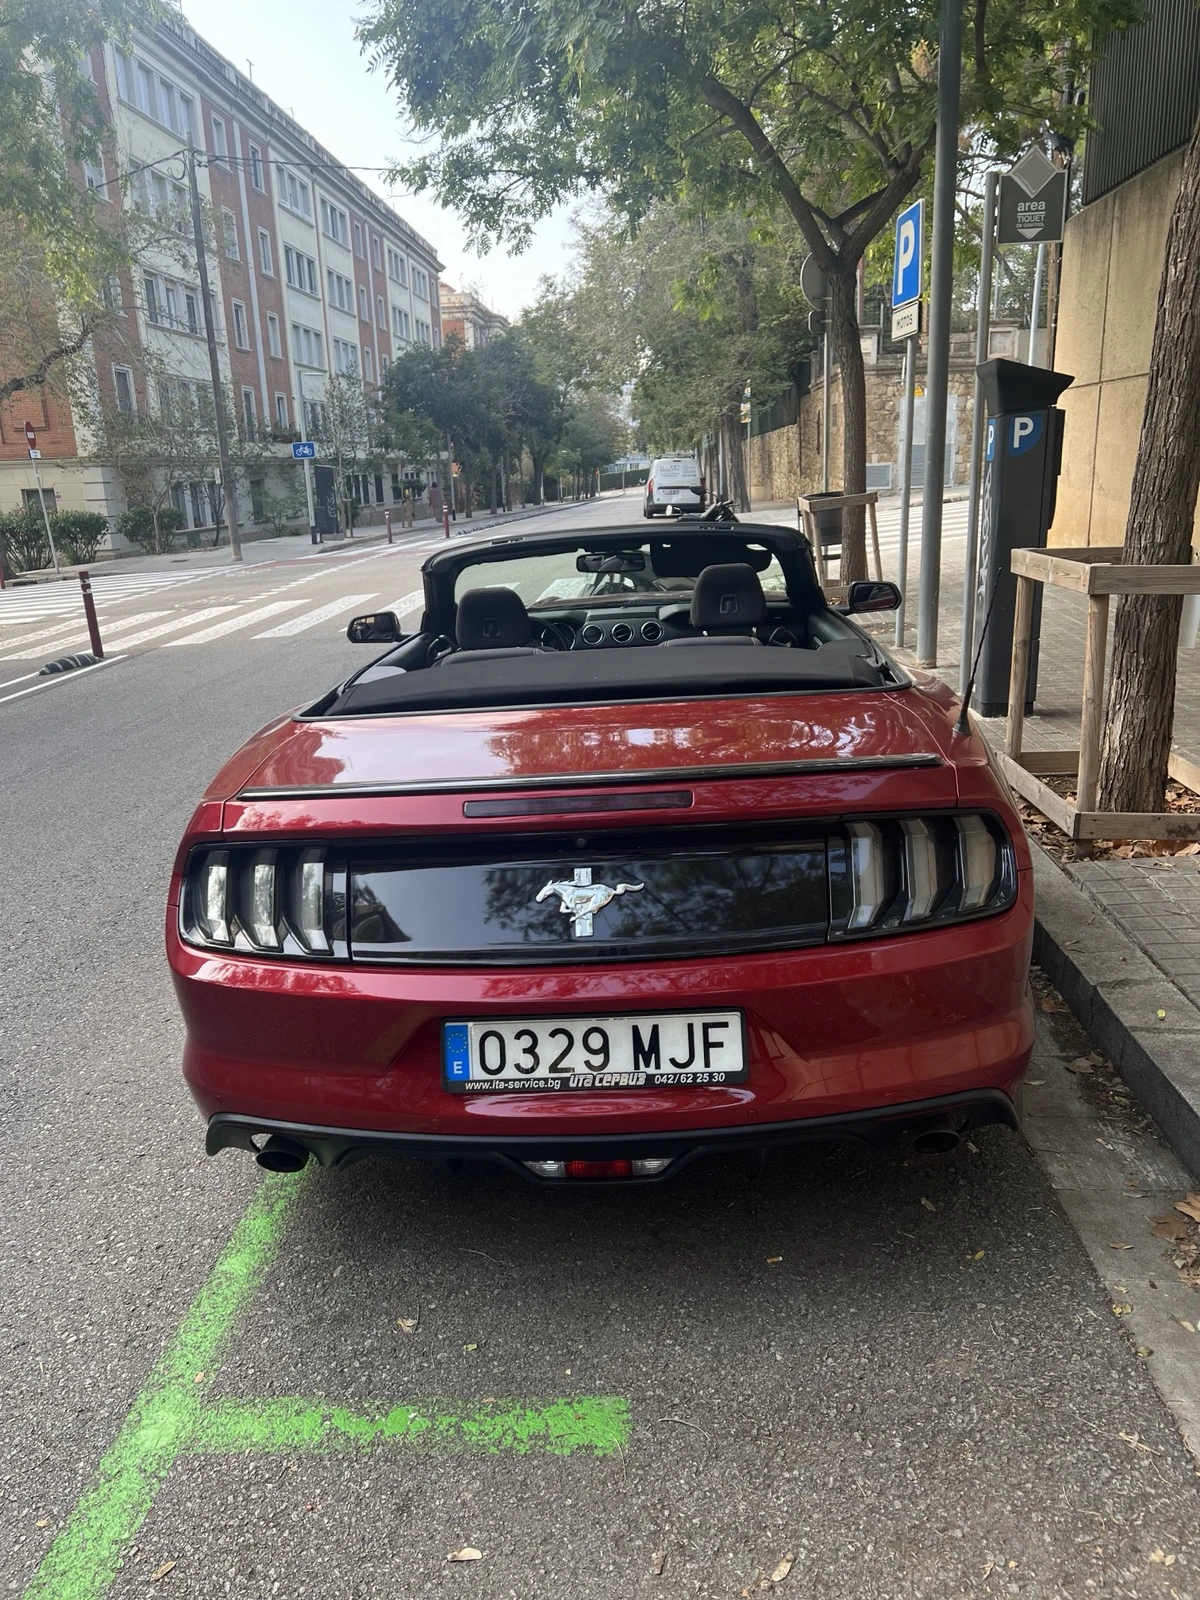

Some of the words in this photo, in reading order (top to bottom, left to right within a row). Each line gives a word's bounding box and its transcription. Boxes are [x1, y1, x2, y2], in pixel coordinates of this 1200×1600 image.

[1017, 201, 1046, 212] area
[1017, 214, 1046, 223] TIQUET
[897, 219, 915, 296] P
[896, 313, 913, 331] MOTOS
[1013, 416, 1034, 448] P
[987, 425, 994, 456] P
[478, 1026, 610, 1076] 0329
[631, 1021, 730, 1071] MJF
[453, 1061, 463, 1074] E
[465, 1078, 562, 1090] www.ita-service.bg
[654, 1073, 693, 1084] 042/62
[696, 1073, 709, 1083] 25
[712, 1072, 726, 1082] 30
